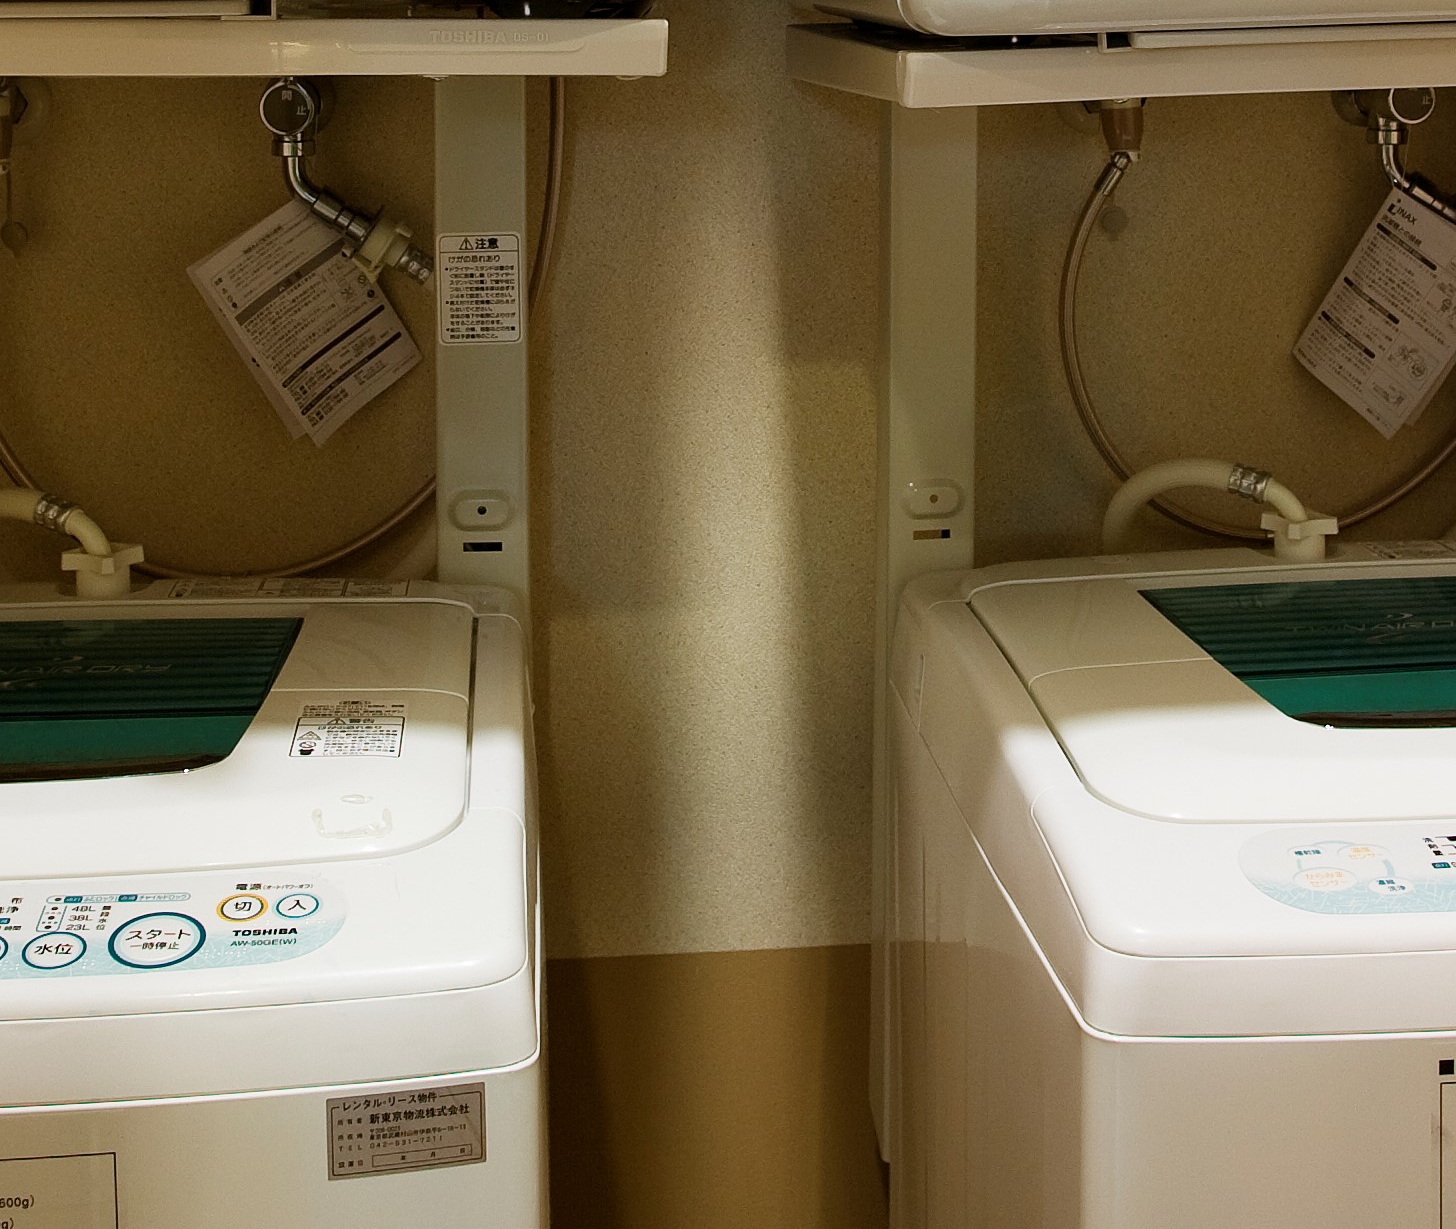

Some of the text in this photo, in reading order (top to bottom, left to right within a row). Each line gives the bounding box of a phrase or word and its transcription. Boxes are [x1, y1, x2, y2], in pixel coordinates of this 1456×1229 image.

[475, 238, 499, 250] 注意
[234, 901, 252, 911] 切
[288, 899, 307, 911] 入
[126, 930, 191, 940] スタート
[232, 928, 298, 936] TOSHIBA
[34, 944, 72, 955] 水位
[342, 1092, 437, 1111] レンタル・リース物件
[369, 1104, 470, 1124] 新東京物流株式会社
